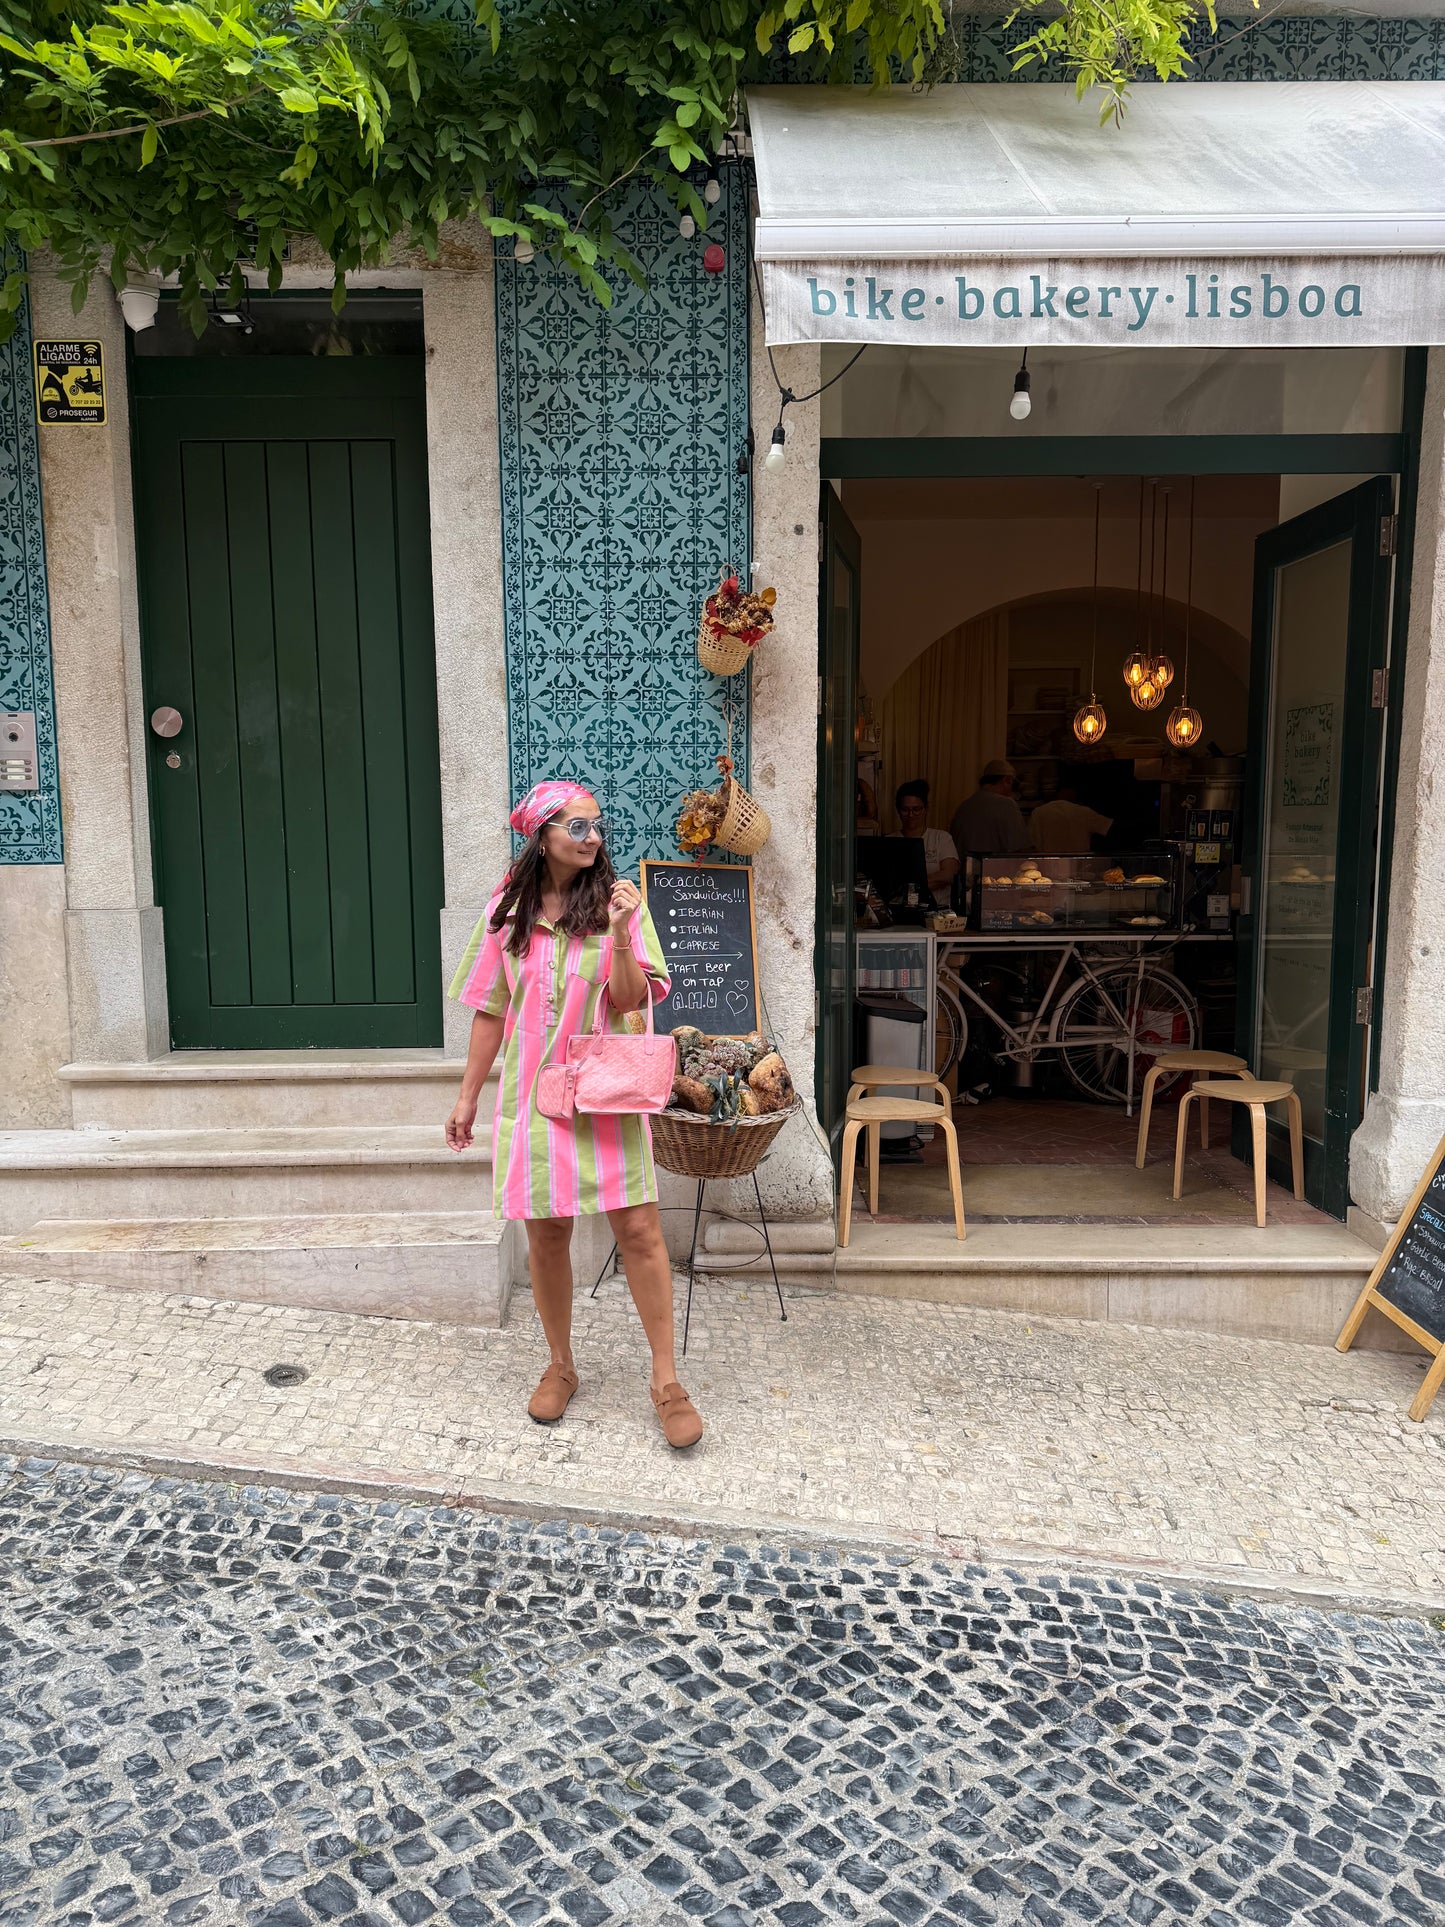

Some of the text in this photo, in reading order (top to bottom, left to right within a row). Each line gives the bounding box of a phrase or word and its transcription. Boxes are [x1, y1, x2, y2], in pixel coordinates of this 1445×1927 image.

[40, 344, 80, 352] ALARME
[40, 352, 81, 361] LIGADO
[83, 357, 98, 365] 24h
[1294, 745, 1321, 759] bakery
[653, 871, 719, 890] Focaccia
[679, 941, 720, 951] CAPRESE
[705, 962, 732, 973] Beer
[682, 978, 697, 987] on
[1431, 1255, 1445, 1273] Brea
